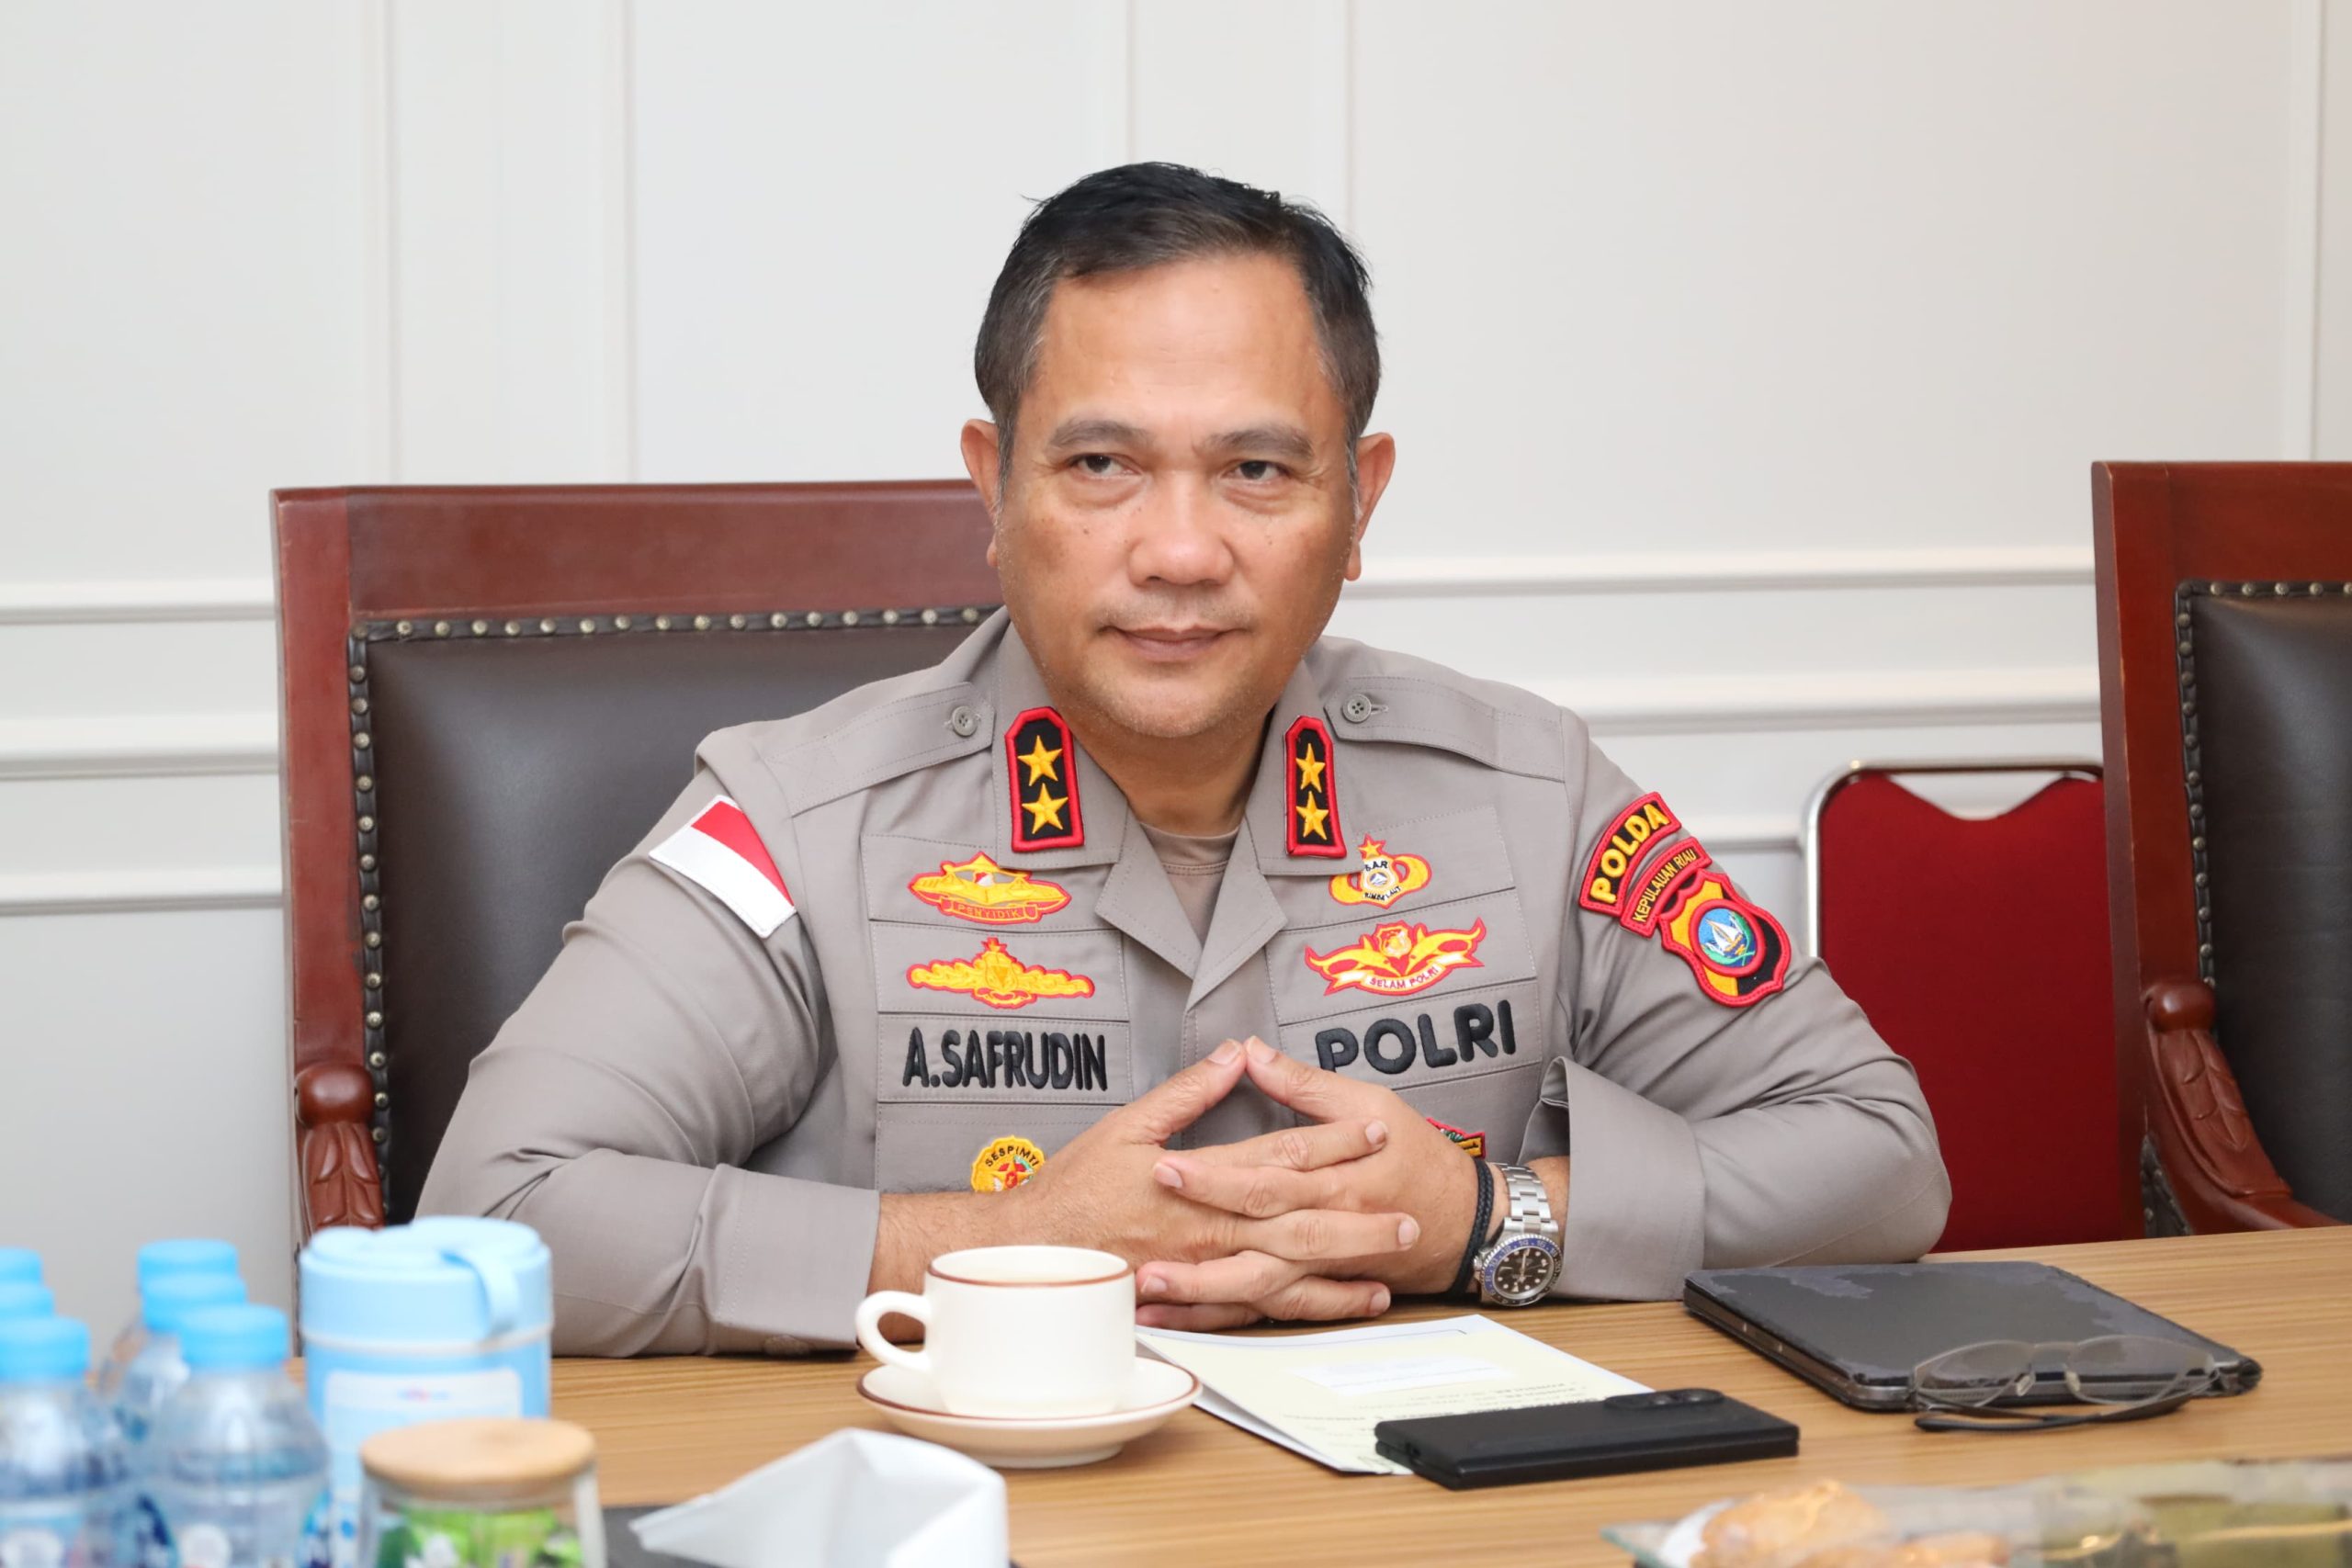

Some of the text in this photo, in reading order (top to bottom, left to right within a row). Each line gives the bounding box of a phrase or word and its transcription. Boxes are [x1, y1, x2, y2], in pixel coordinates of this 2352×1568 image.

[1590, 804, 1670, 905] POLDA
[1633, 848, 1697, 922] KEPULAUAN RIAU
[957, 904, 1021, 919] PENYIDIK
[1370, 966, 1440, 989] SELAM POLRI
[902, 1026, 1108, 1091] A.SAFRUDIN
[1315, 999, 1516, 1075] POLRI
[985, 1145, 1040, 1168] SESPIMTI
